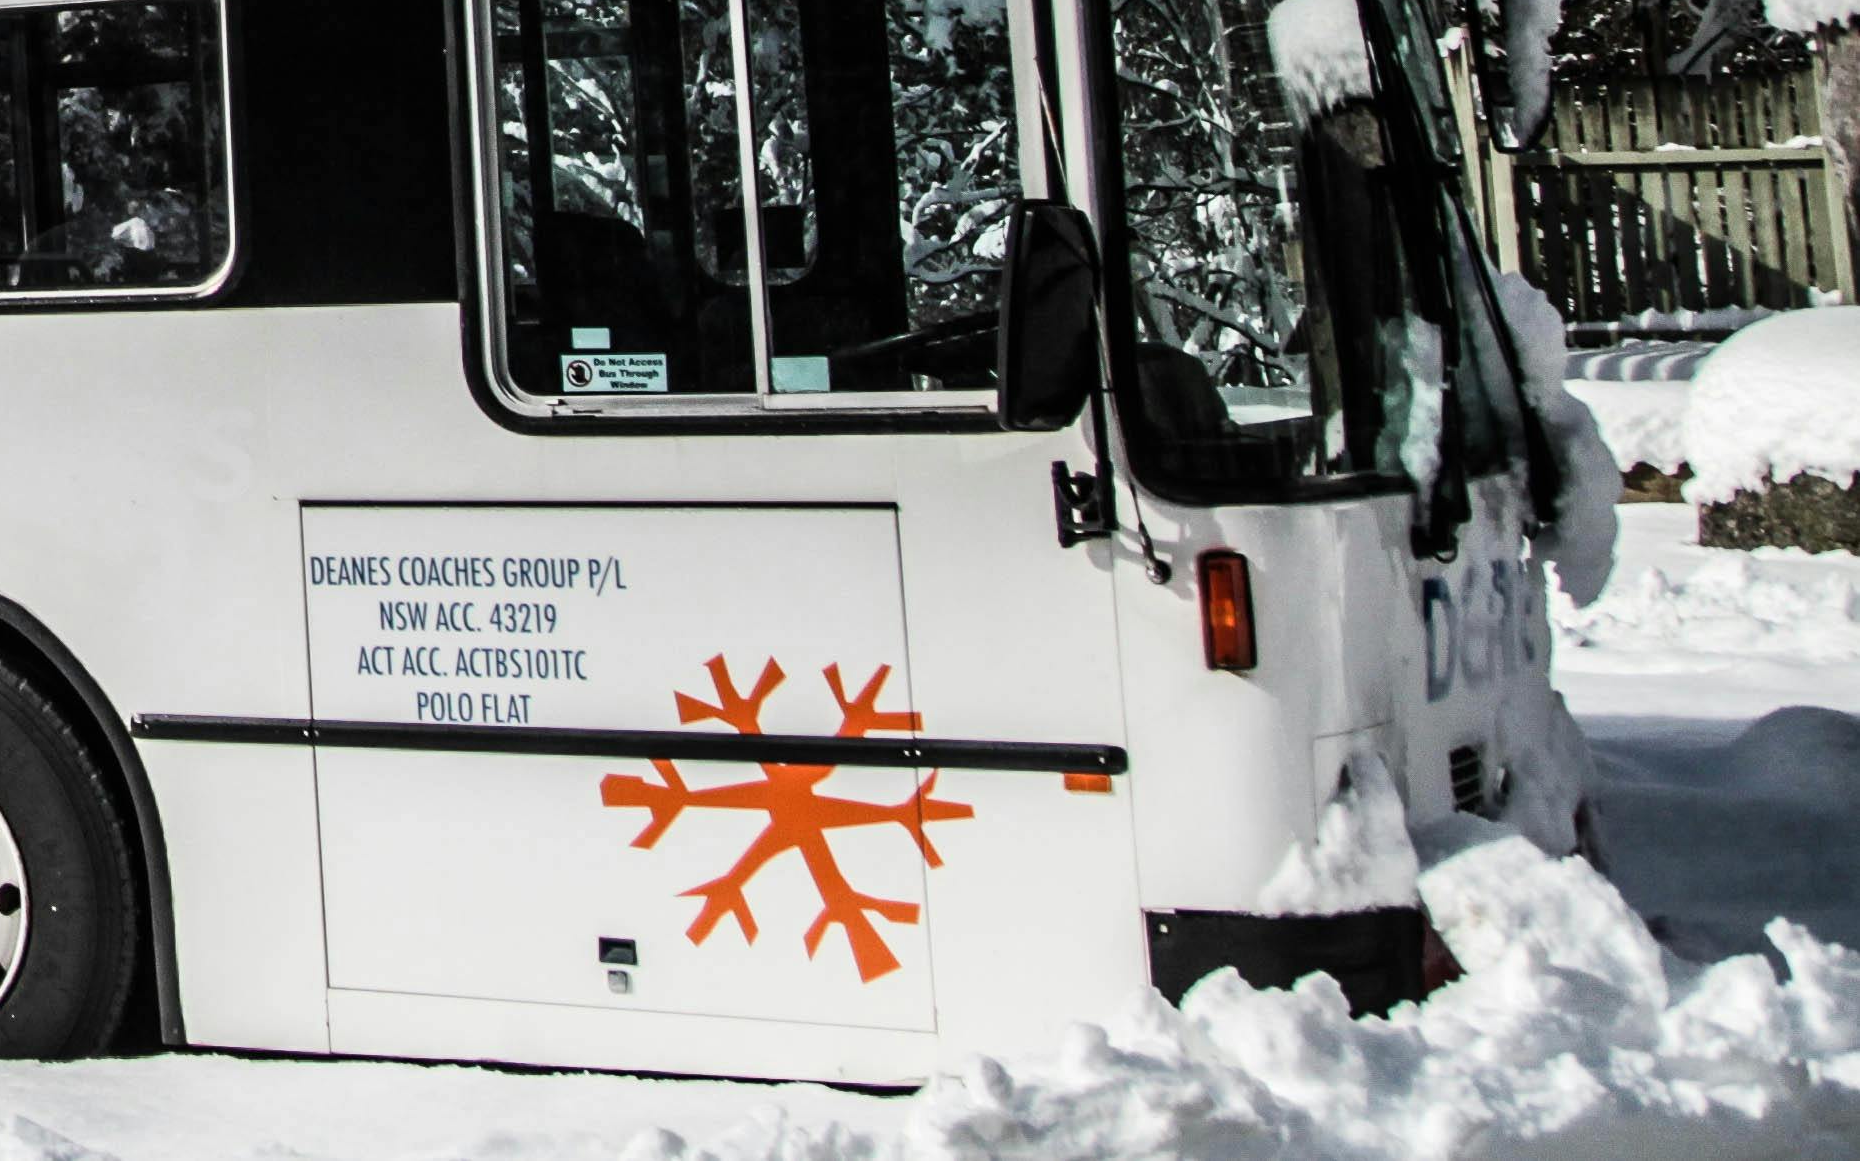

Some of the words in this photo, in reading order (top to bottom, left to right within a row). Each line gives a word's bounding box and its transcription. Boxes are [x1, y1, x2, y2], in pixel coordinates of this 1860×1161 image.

[593, 357, 606, 366] Do
[608, 357, 626, 366] Not
[628, 357, 664, 367] Access
[598, 369, 617, 378] Bus
[619, 368, 660, 380] Through
[310, 556, 391, 586] DEANES
[398, 556, 495, 587] COACHES
[502, 557, 581, 589] GROUP
[588, 555, 627, 597] P/L
[379, 601, 428, 631] NSW
[435, 601, 482, 633] ACC.
[489, 602, 558, 634] 43219
[357, 646, 396, 676] ACT
[402, 646, 448, 678] ACC.
[455, 646, 588, 681] ACTBS101TC
[416, 691, 474, 722] POLO
[480, 693, 532, 725] FLAT
